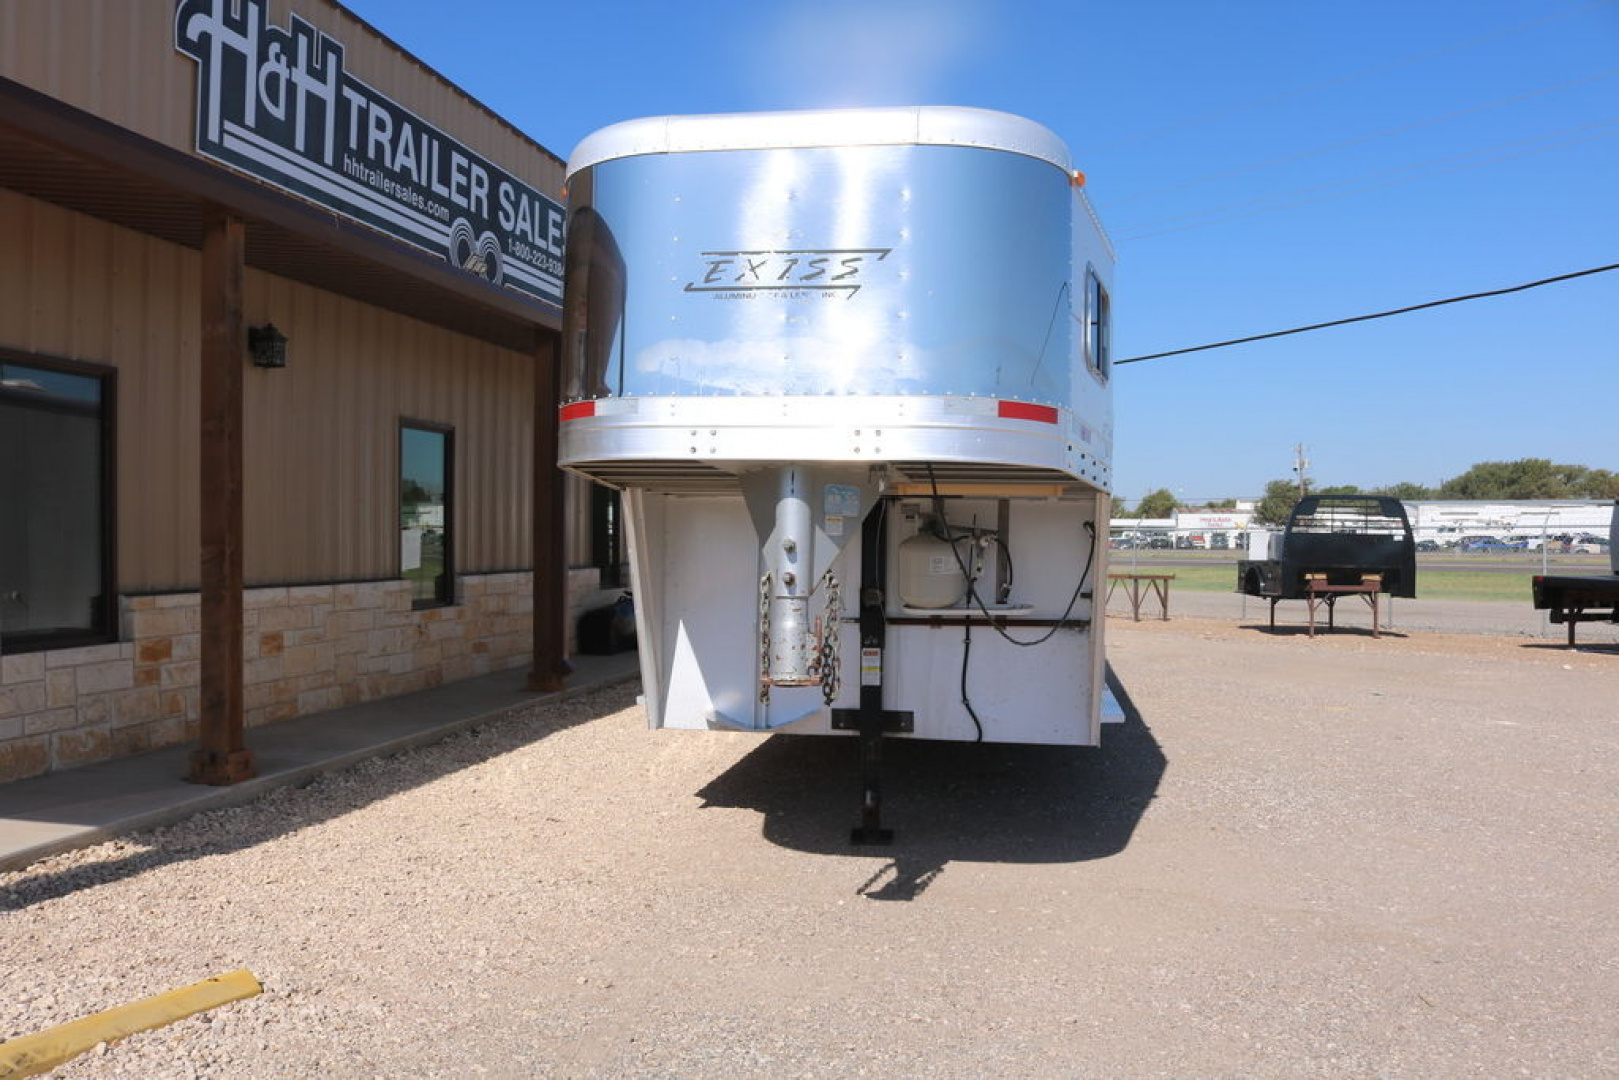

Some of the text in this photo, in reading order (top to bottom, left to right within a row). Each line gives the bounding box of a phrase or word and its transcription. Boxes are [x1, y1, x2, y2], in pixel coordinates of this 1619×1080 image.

[186, 0, 566, 257] H&H TRAILER SALE
[343, 152, 450, 222] hhtrailersales.com
